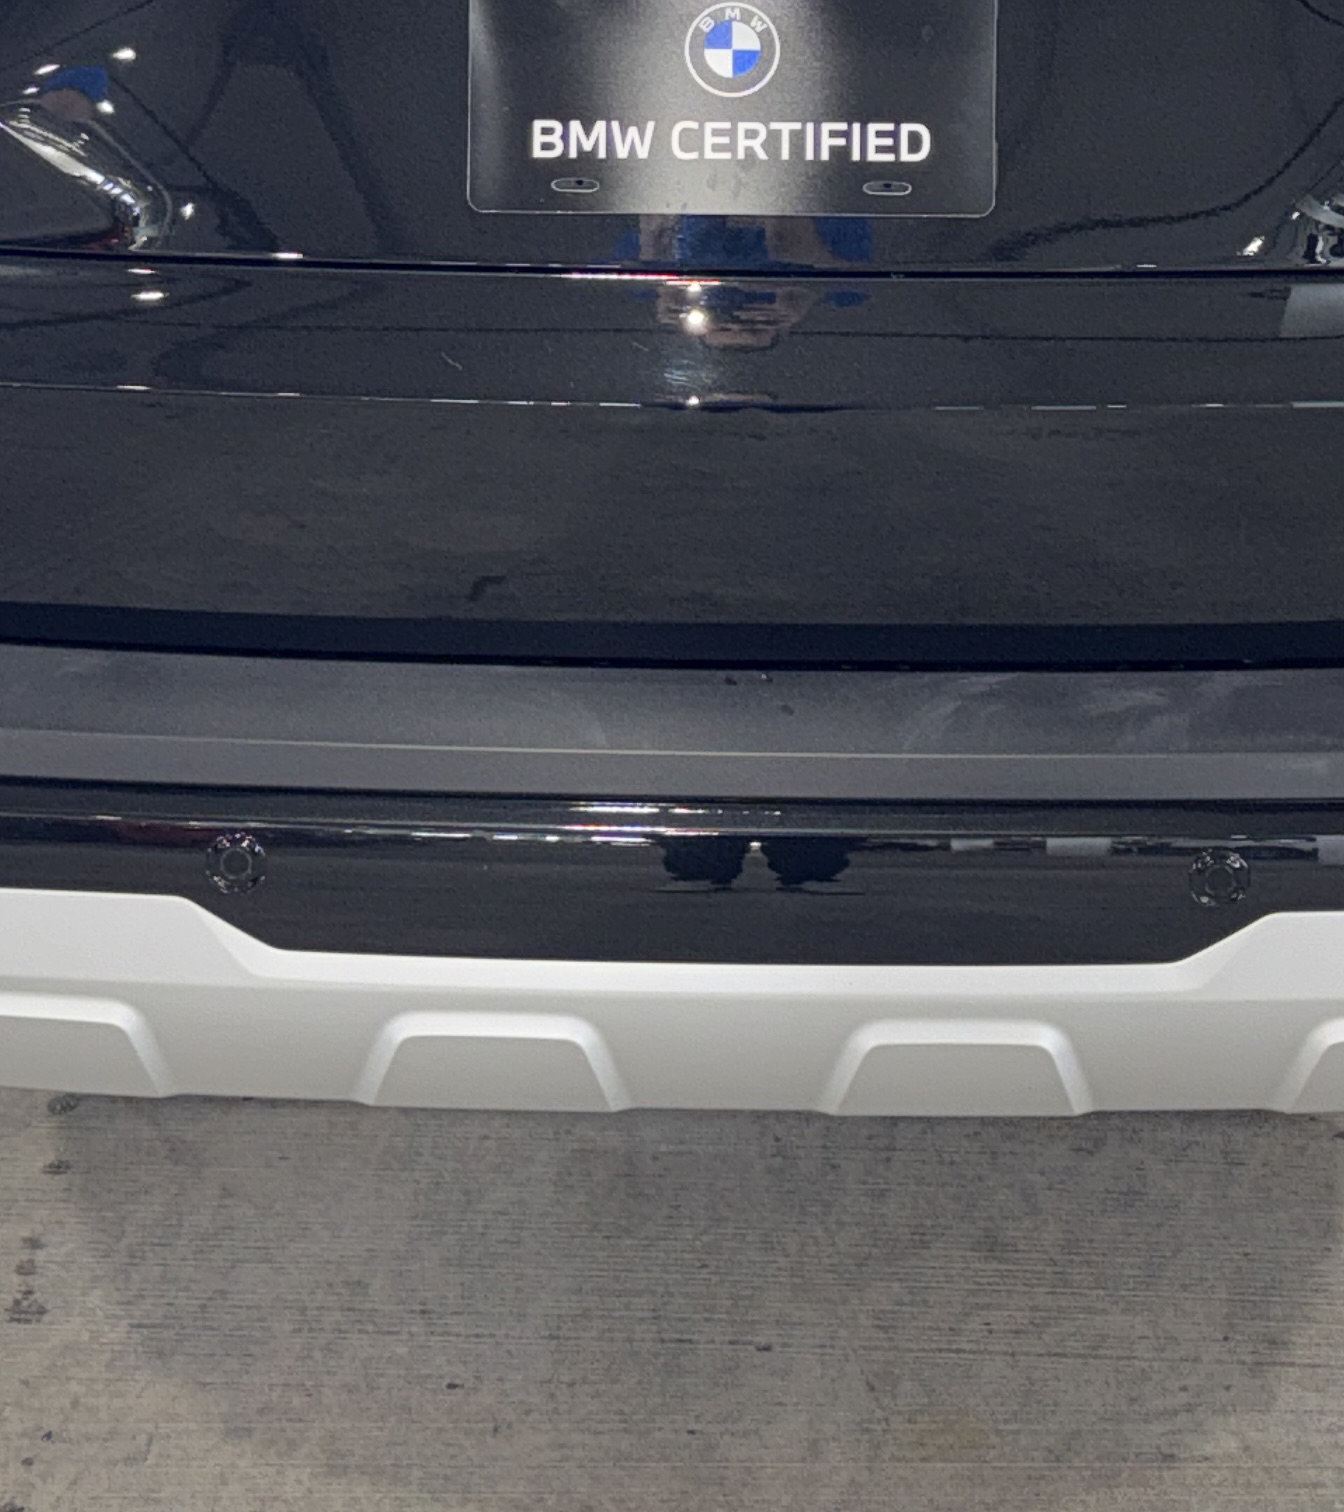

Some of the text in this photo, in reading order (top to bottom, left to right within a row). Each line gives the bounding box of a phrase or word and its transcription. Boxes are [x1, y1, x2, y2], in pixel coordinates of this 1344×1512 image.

[698, 7, 769, 34] BMW
[531, 119, 932, 163] BMW CERTIFIED
